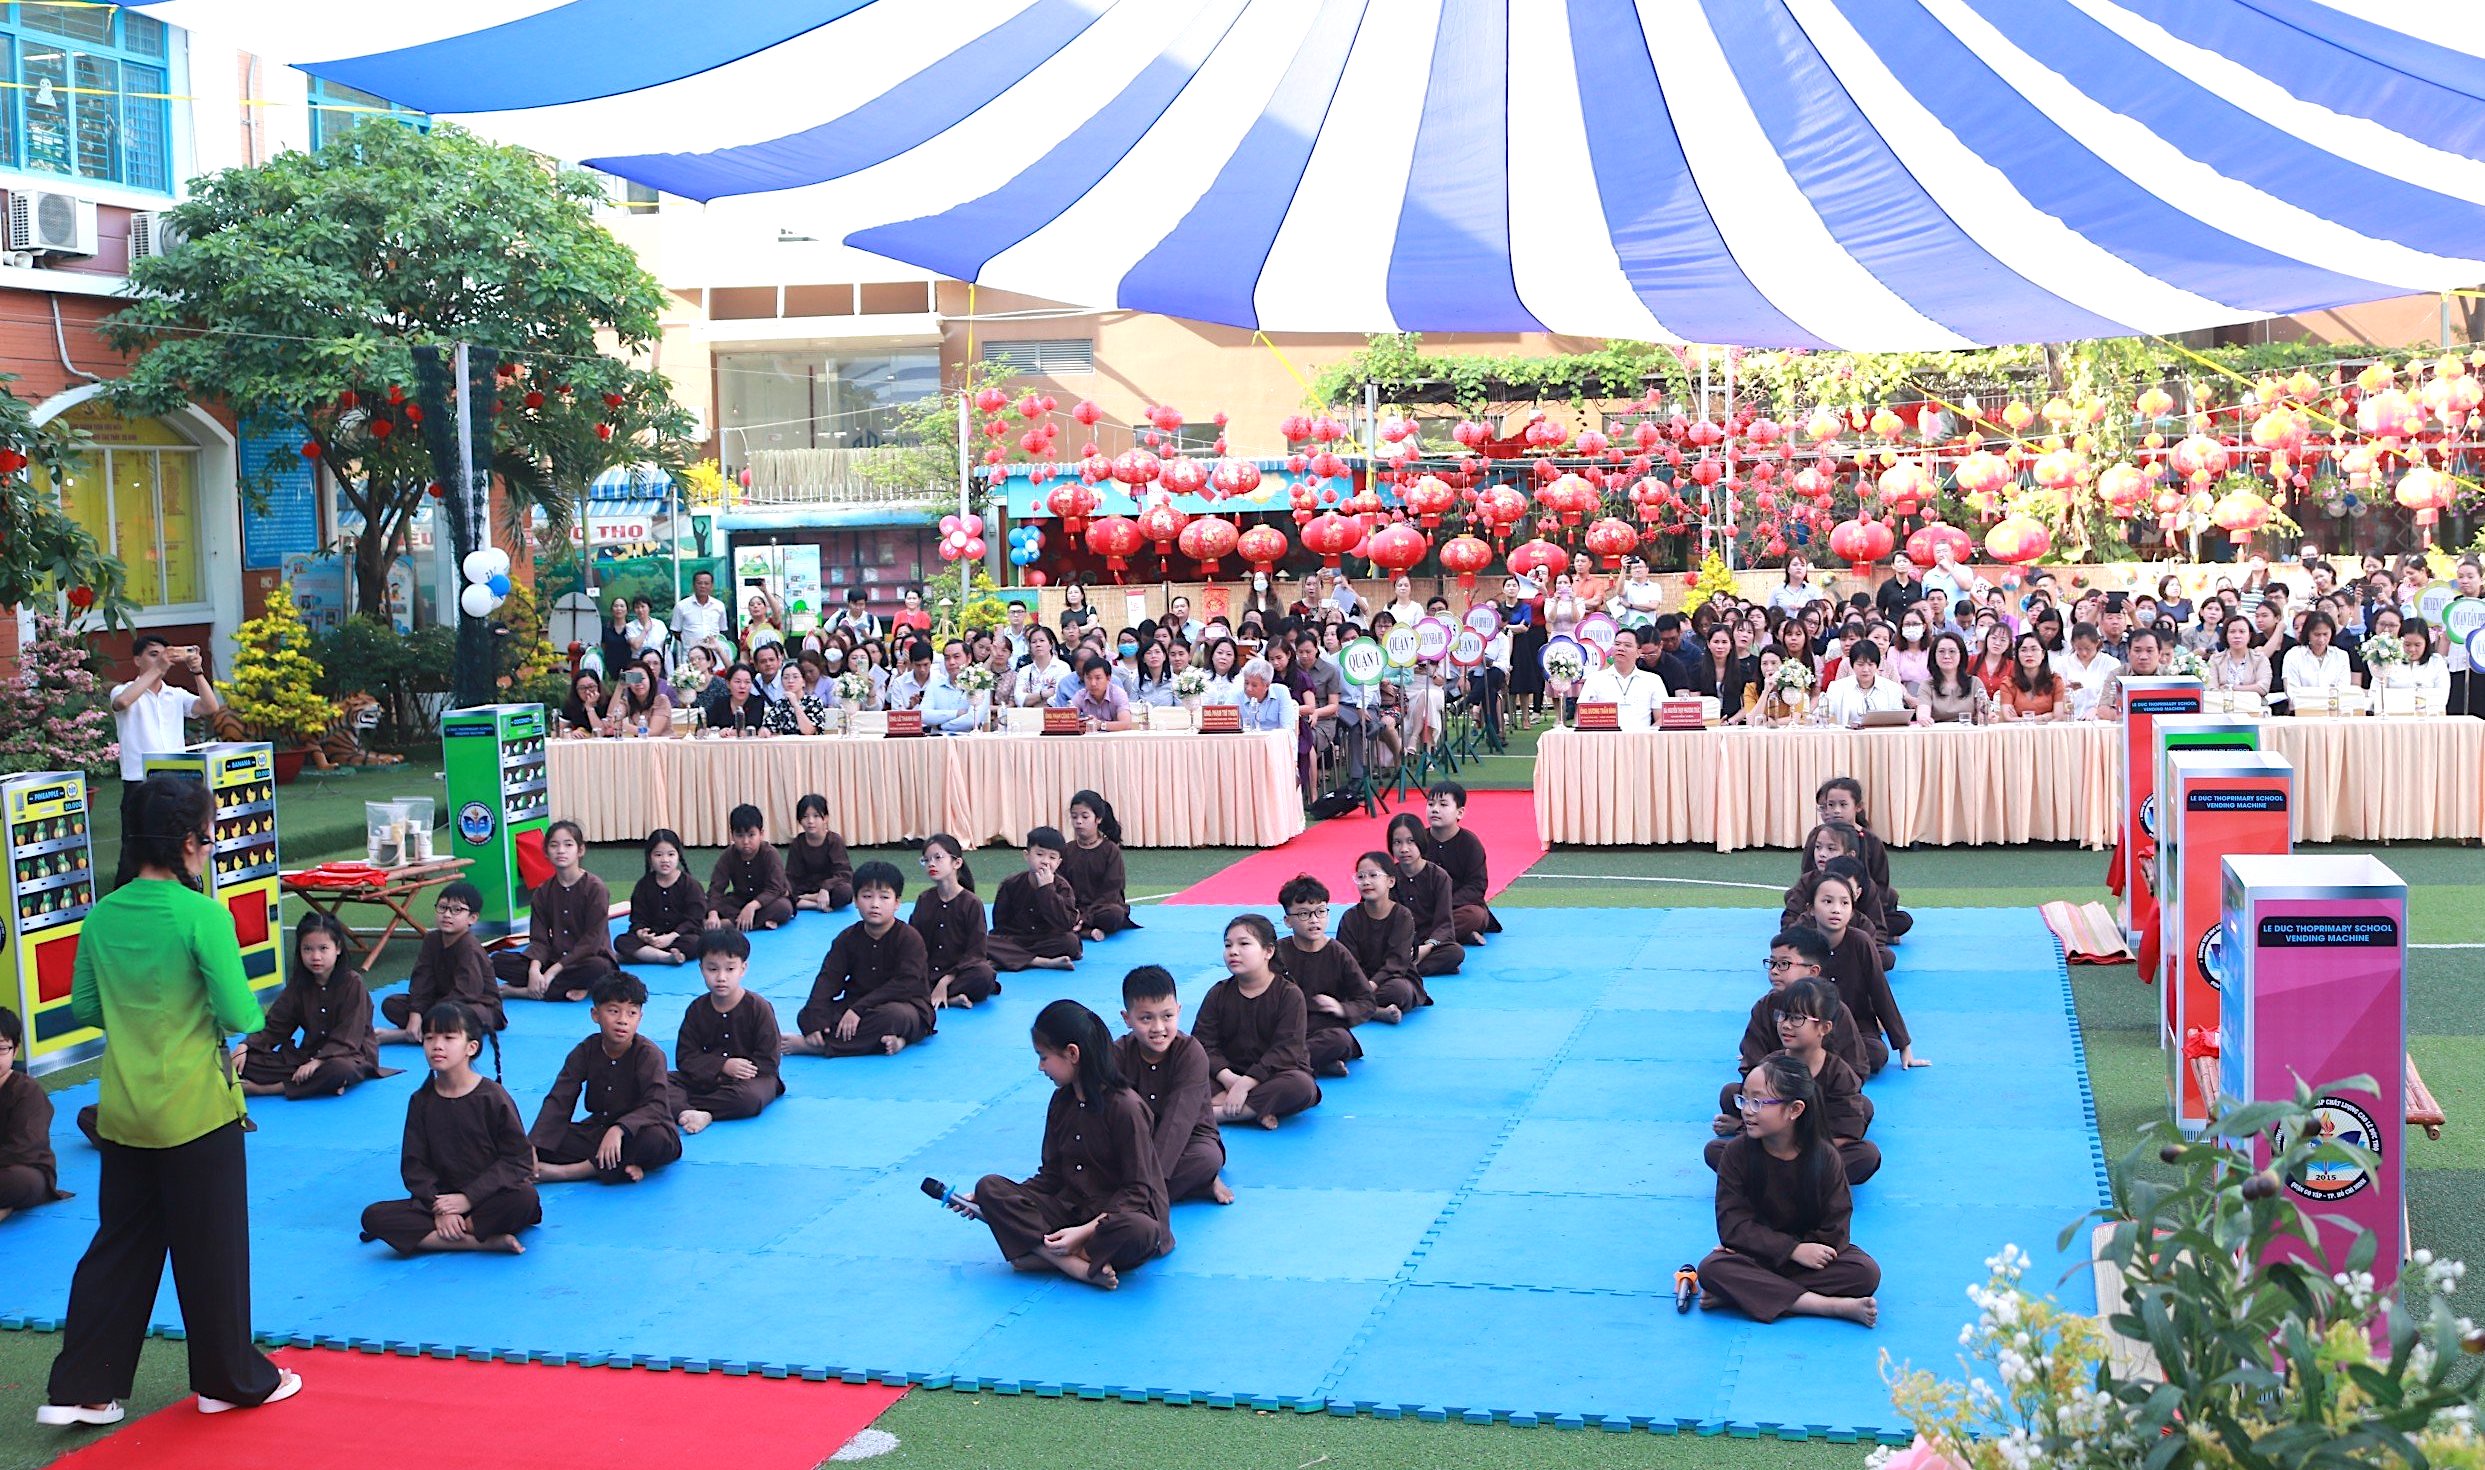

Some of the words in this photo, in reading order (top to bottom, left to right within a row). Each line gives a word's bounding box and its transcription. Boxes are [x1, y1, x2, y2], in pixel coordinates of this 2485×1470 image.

[596, 524, 642, 540] THỌ
[1390, 634, 1409, 654] QUẬN
[1410, 637, 1414, 650] 7
[1348, 650, 1375, 672] QUẬN
[1375, 651, 1380, 665] 1
[1591, 652, 1598, 666] 12
[232, 759, 251, 768] BANANA
[34, 790, 59, 800] PINEAPPLE
[2358, 1112, 2368, 1123] CAO
